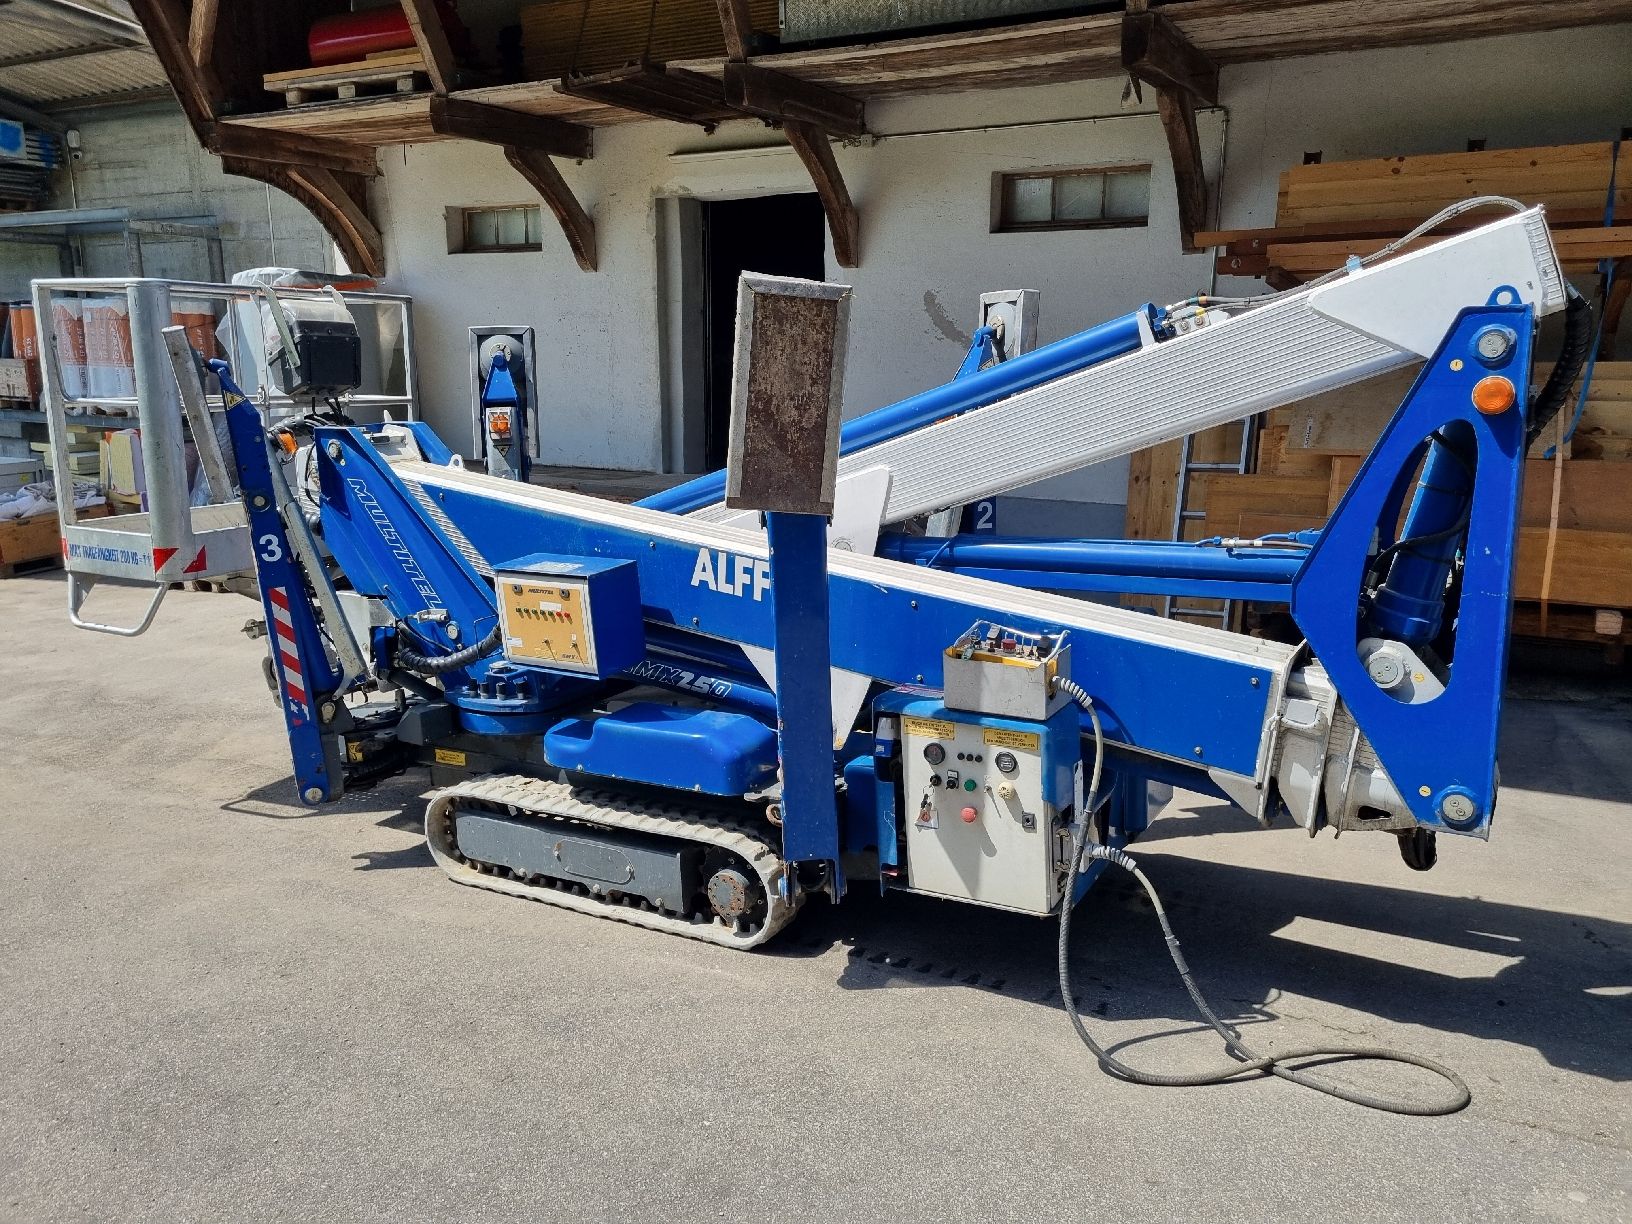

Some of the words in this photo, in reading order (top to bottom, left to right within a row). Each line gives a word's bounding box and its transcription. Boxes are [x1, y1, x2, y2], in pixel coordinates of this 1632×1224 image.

[977, 501, 993, 529] 2
[259, 533, 282, 562] 3
[347, 478, 442, 609] MULTITEL
[690, 547, 770, 601] ALFF
[622, 660, 732, 698] MX250
